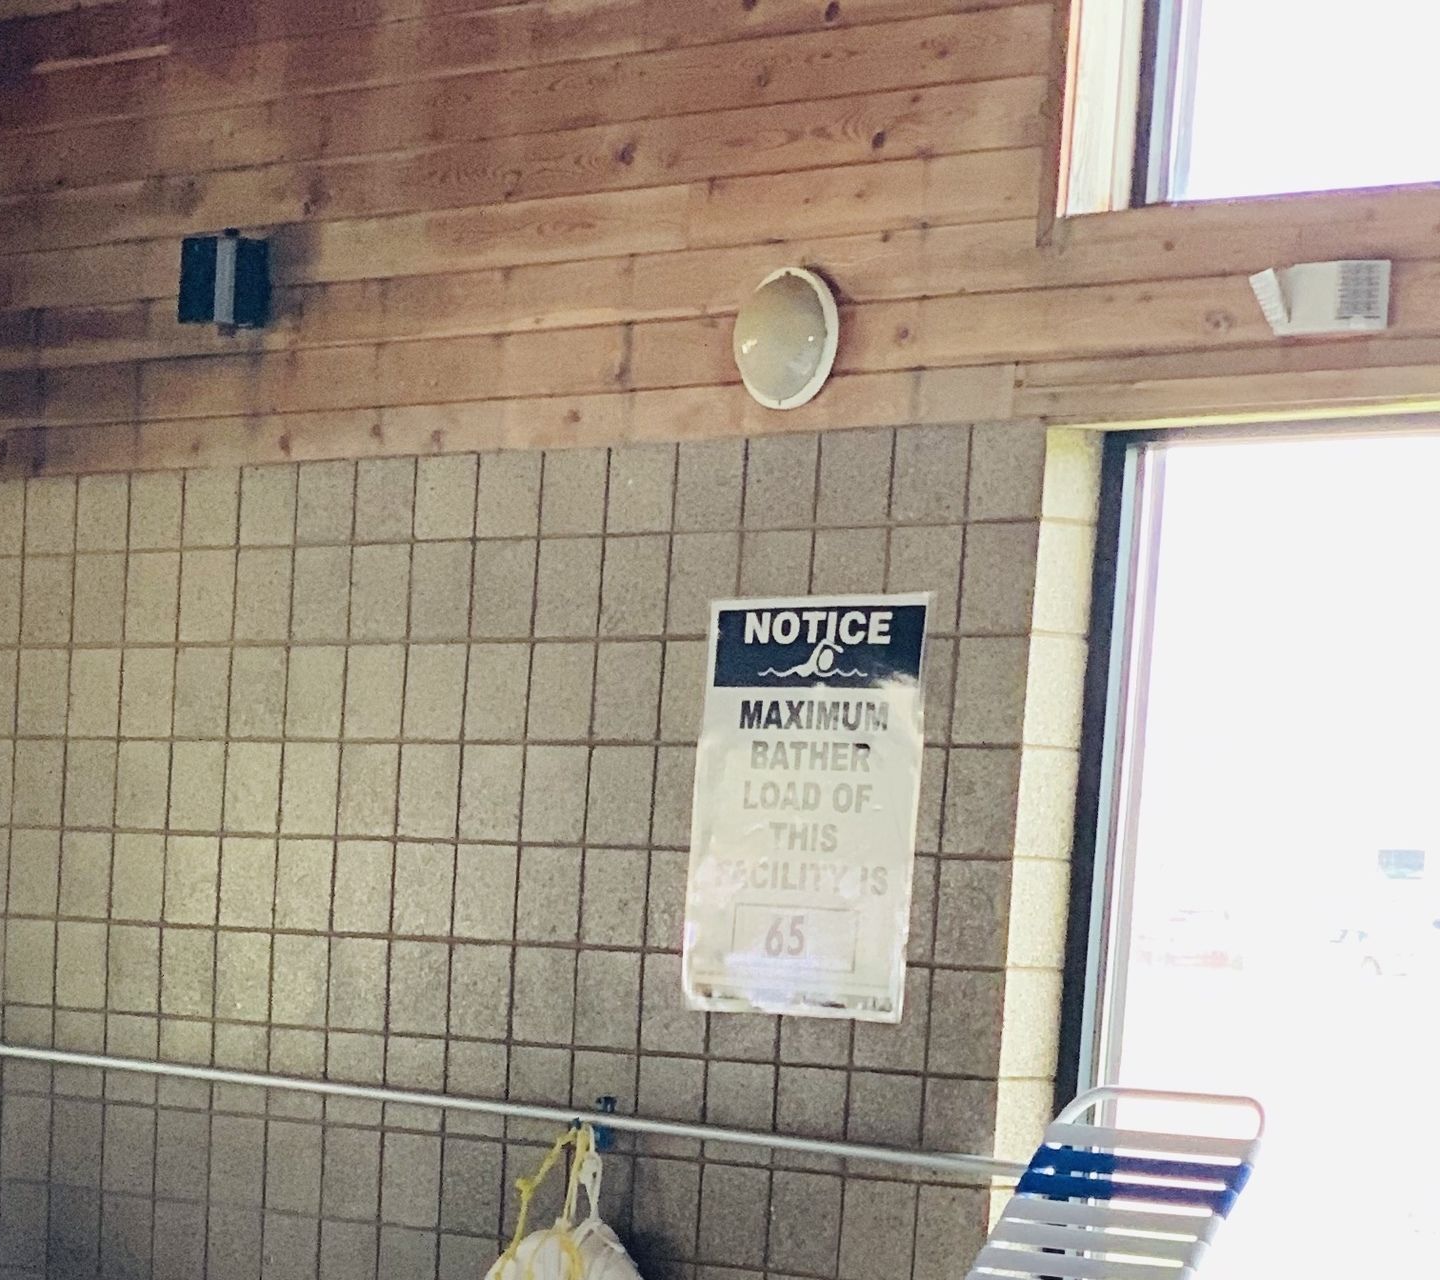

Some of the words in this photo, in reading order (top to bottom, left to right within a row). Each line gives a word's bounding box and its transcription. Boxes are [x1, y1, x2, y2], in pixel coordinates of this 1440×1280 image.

[744, 611, 893, 645] NOTICE
[739, 700, 890, 731] MAXIMUM
[750, 740, 871, 773] BATHER
[743, 781, 822, 812] LOAD
[832, 782, 874, 813] OF
[769, 822, 839, 852] THIS
[765, 915, 805, 957] 65
